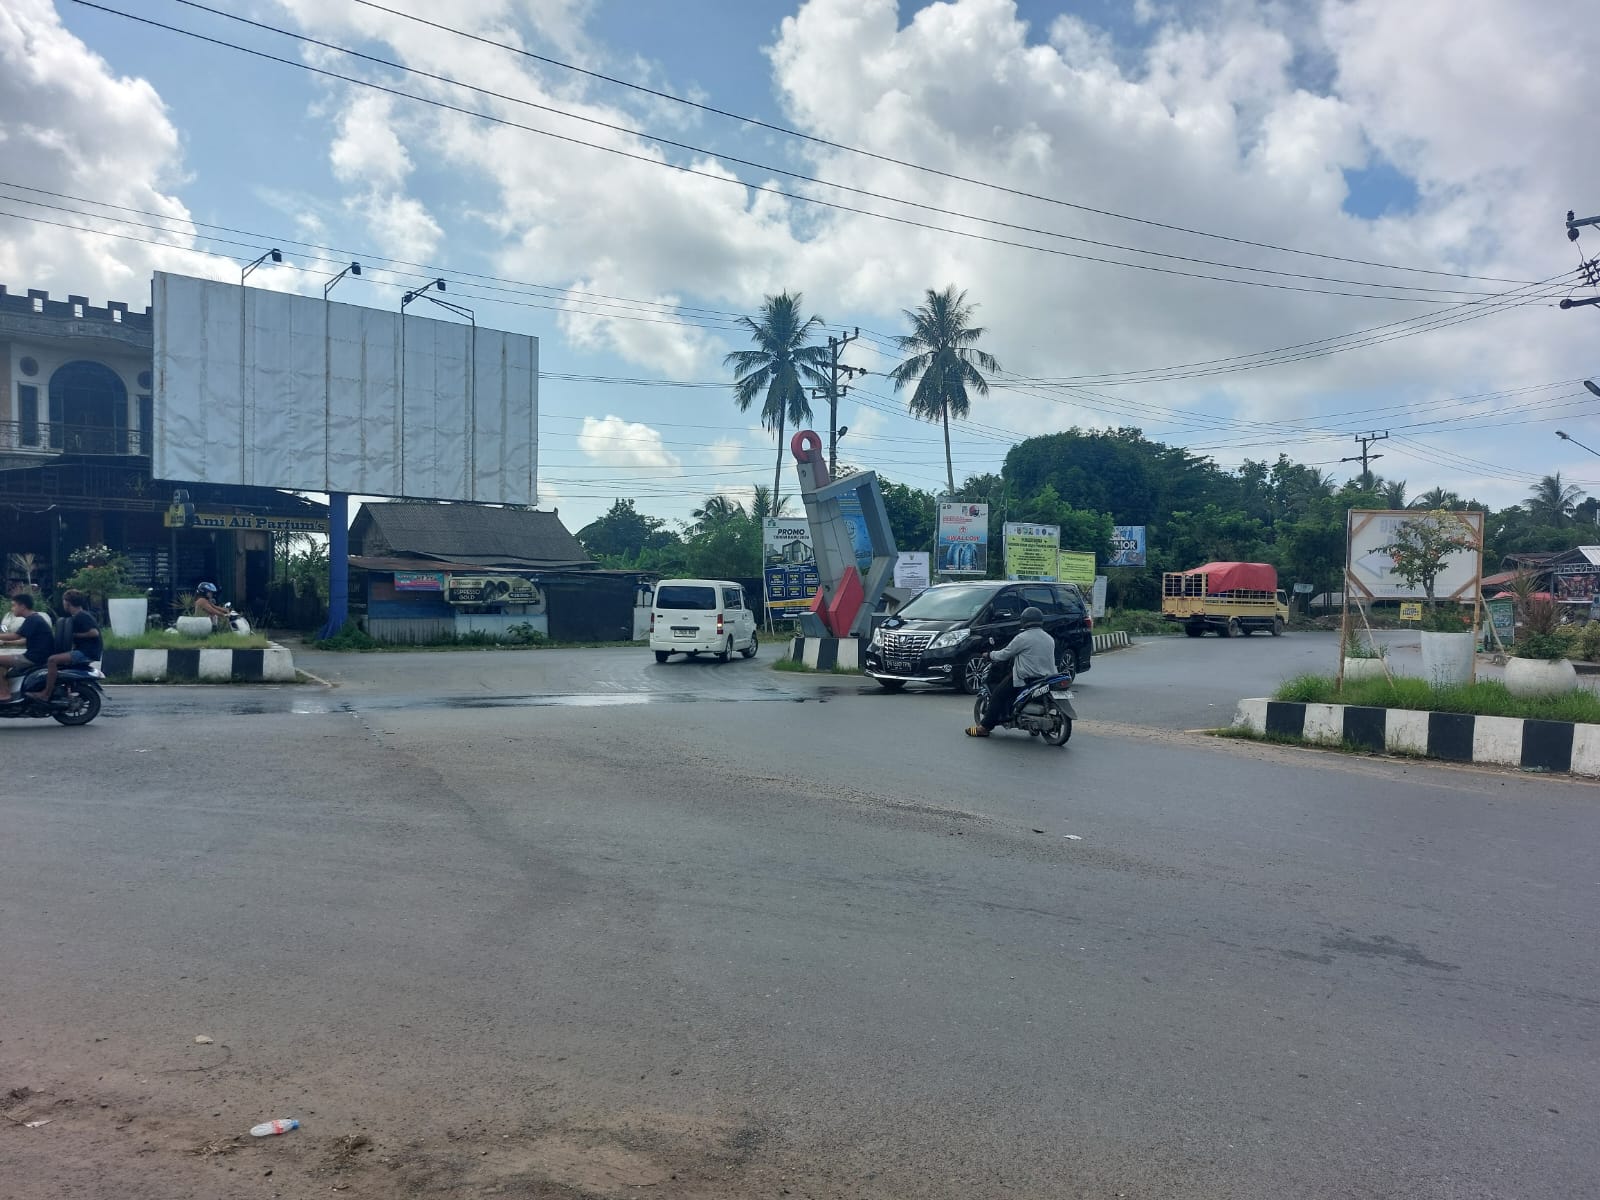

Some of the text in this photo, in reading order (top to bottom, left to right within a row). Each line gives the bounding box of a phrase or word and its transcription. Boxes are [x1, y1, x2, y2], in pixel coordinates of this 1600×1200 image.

[193, 515, 225, 527] Ami
[229, 516, 251, 528] Ali
[256, 518, 324, 530] Parfum's
